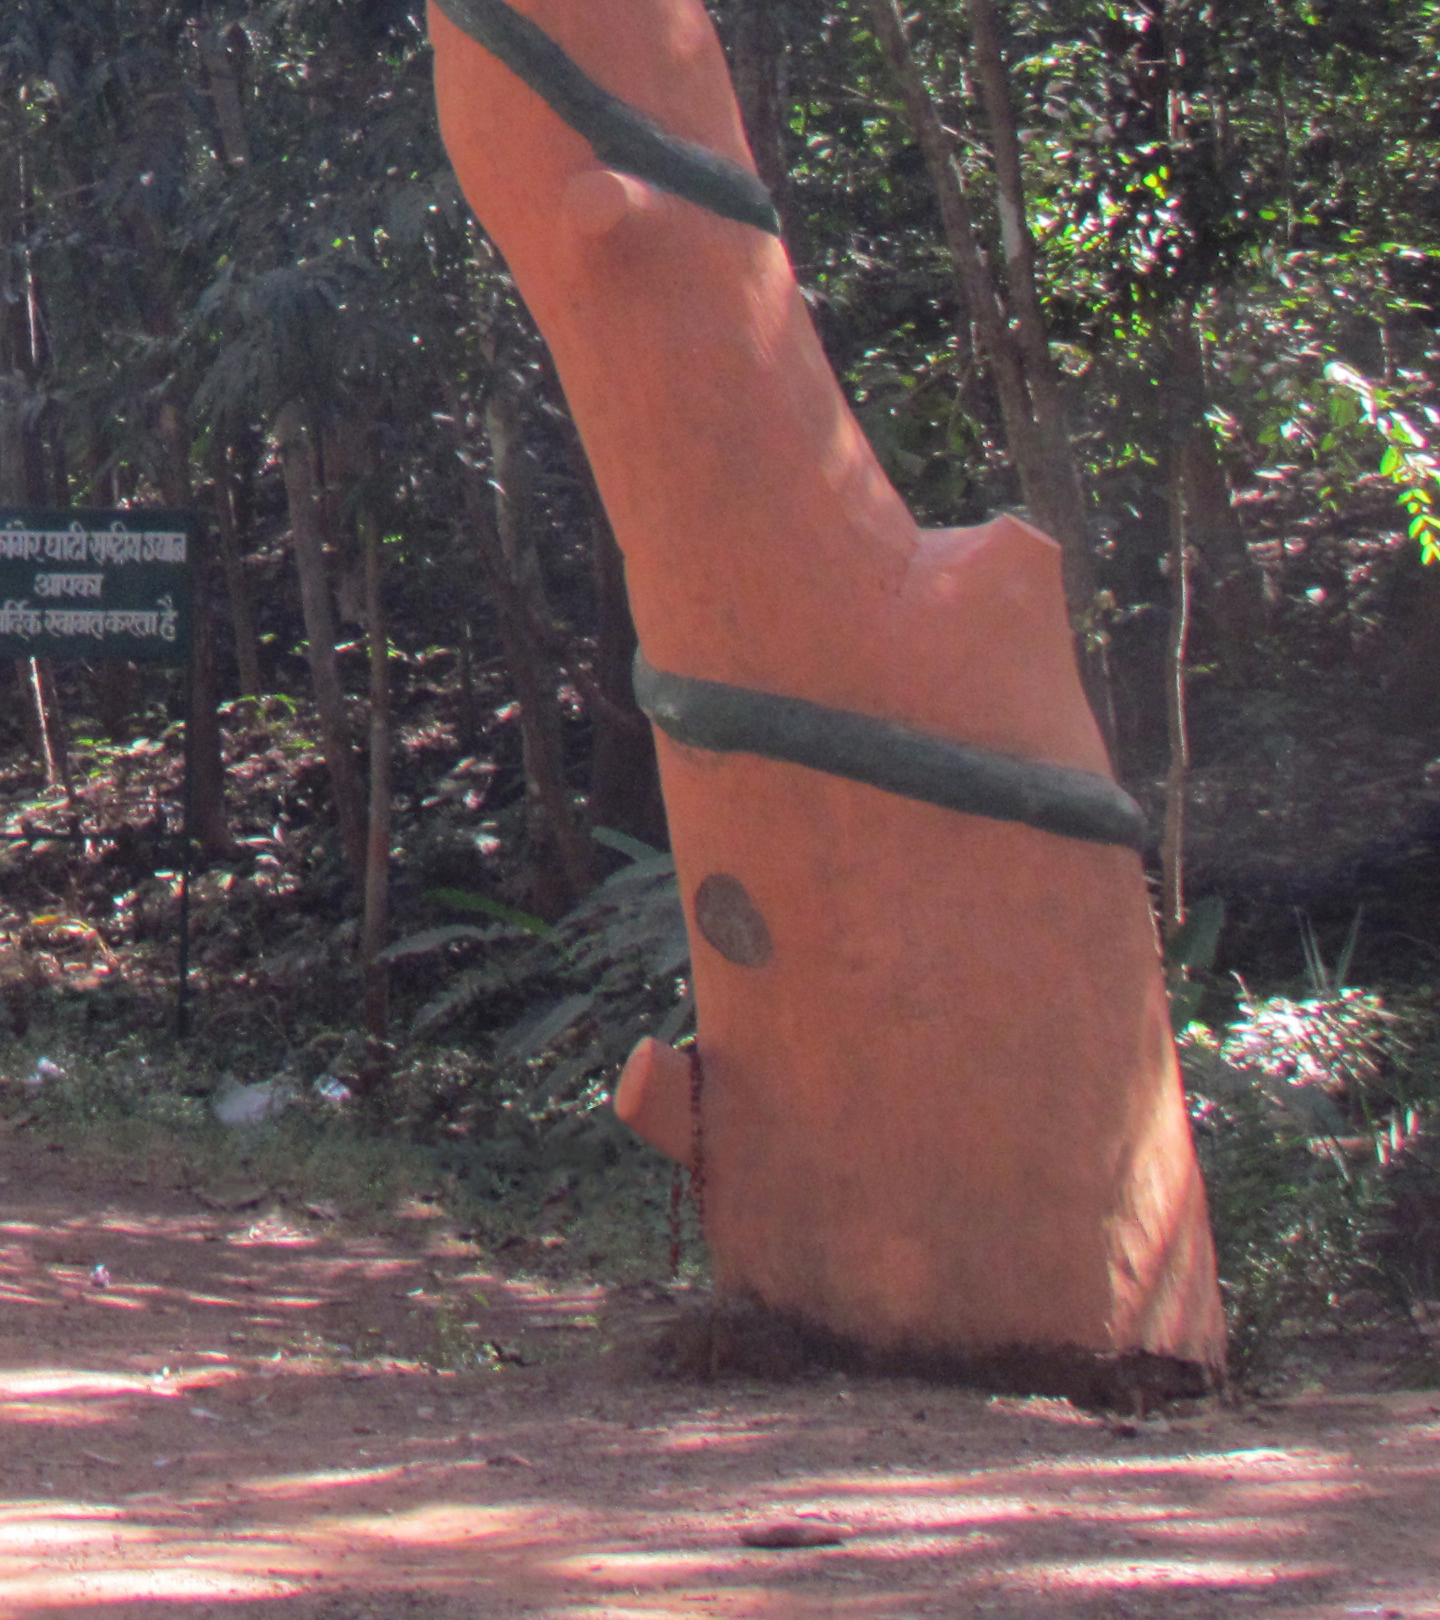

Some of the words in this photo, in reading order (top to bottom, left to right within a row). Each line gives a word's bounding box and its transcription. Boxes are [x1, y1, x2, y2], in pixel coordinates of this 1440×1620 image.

[44, 520, 87, 561] घाटी
[34, 573, 105, 598] आपका
[159, 594, 179, 642] है
